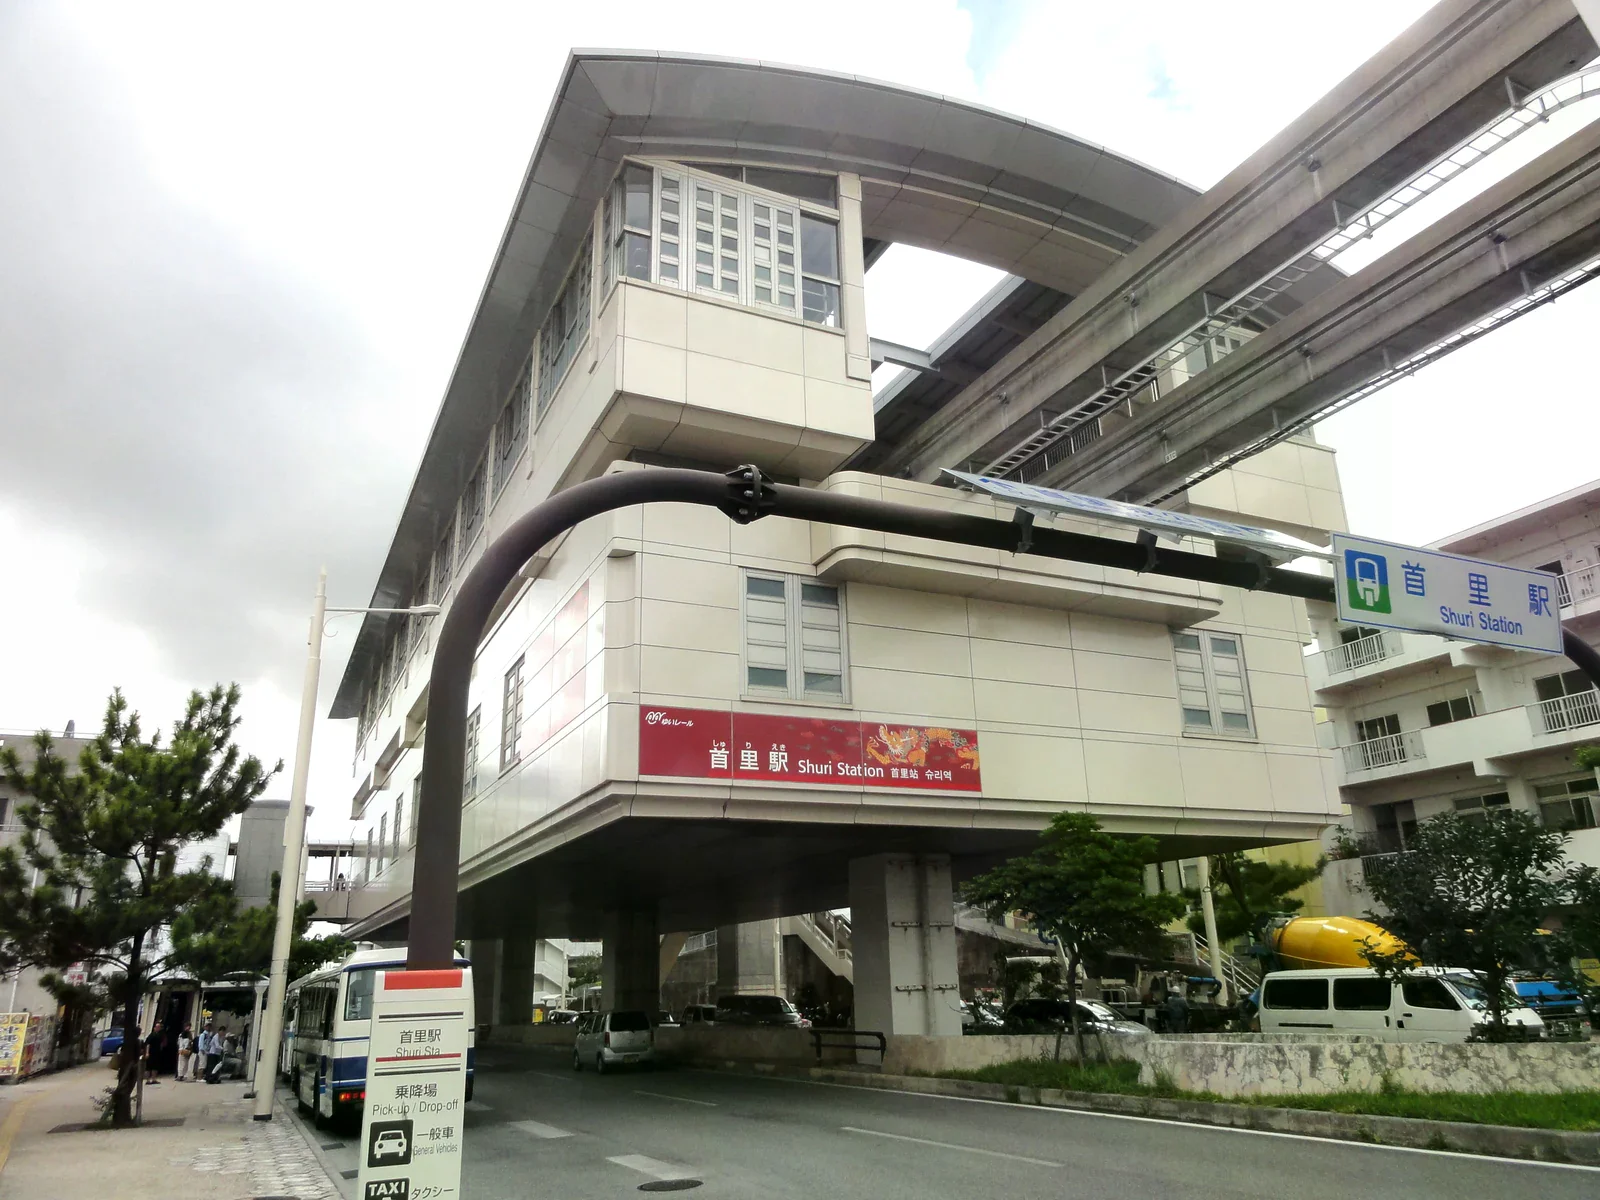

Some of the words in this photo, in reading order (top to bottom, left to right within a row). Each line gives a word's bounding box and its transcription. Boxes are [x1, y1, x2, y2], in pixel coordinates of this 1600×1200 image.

[1401, 560, 1552, 618] 首里駅
[1439, 605, 1474, 628] Shuri
[1479, 611, 1523, 636] Station
[661, 718, 694, 727] ゆいレール
[708, 747, 789, 773] 首里駅
[798, 759, 833, 775] Shuri
[837, 761, 884, 778] Station
[890, 767, 919, 779] 首里站
[924, 769, 952, 781] 슈리역
[400, 1028, 441, 1044] 首里駅
[395, 1046, 421, 1058] Shuri
[395, 1083, 437, 1100] 乗降場
[372, 1103, 410, 1117] Pick-up
[419, 1098, 459, 1114] Drop-off
[417, 1126, 454, 1141] 一般車
[413, 1144, 434, 1156] General
[435, 1143, 458, 1154] Vehicles
[369, 1181, 406, 1196] TAXI
[411, 1186, 455, 1200] タクシー
